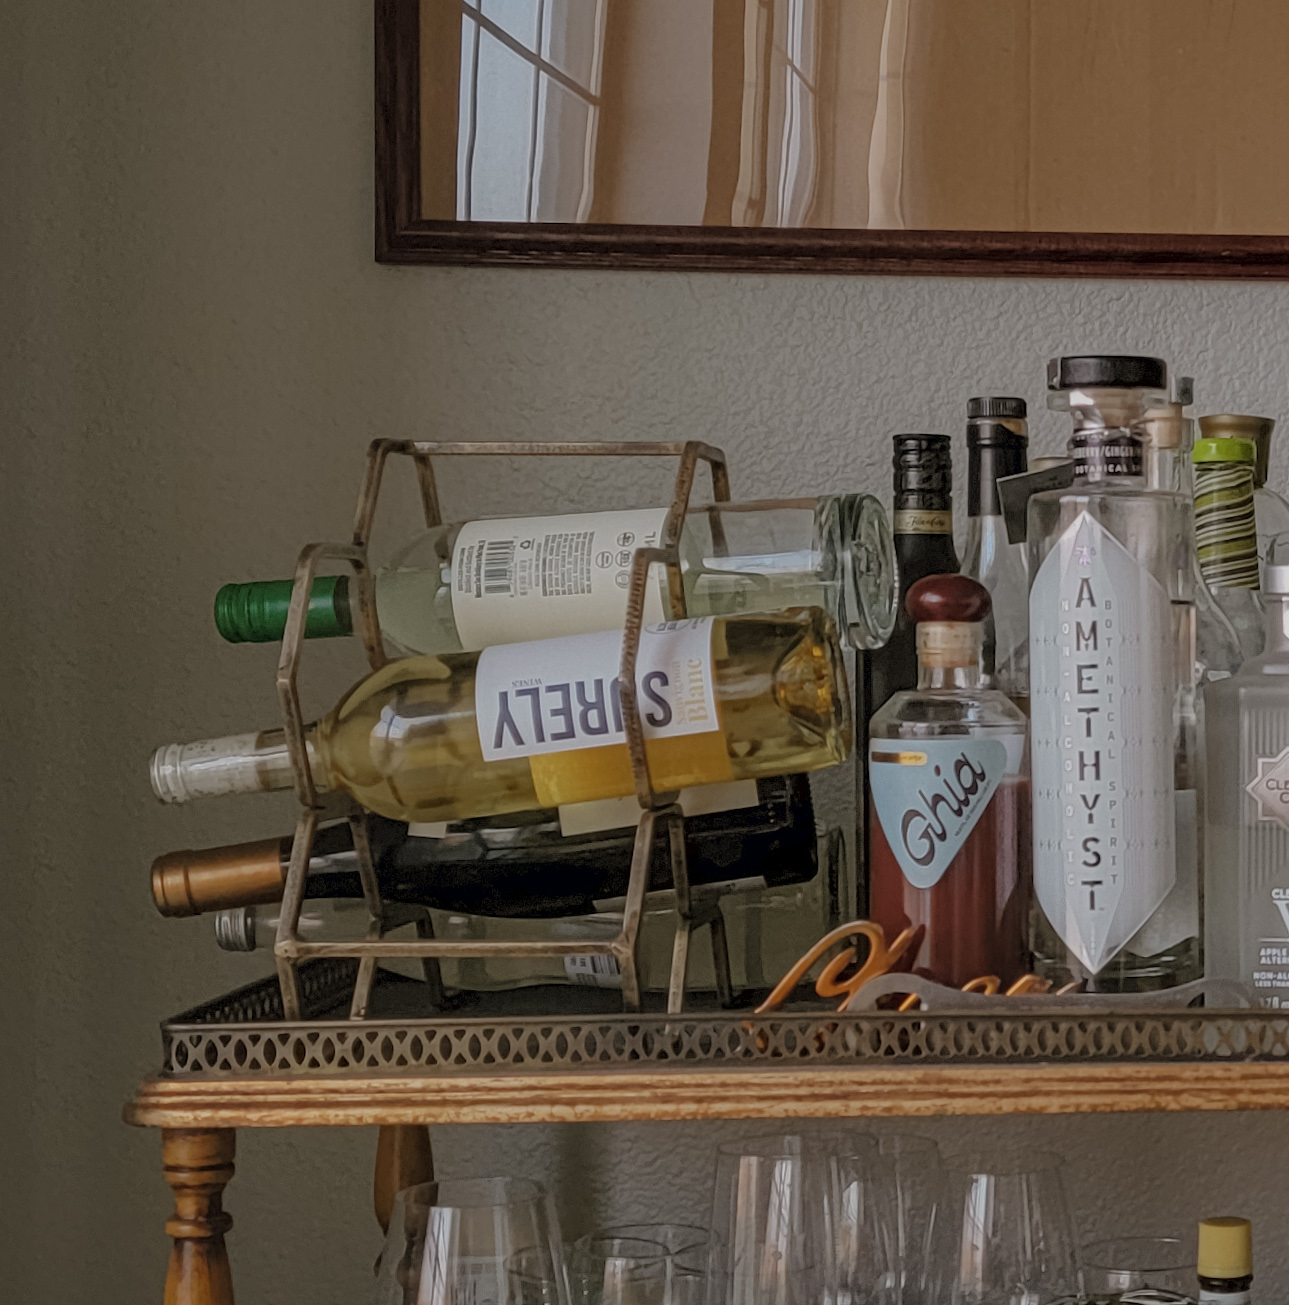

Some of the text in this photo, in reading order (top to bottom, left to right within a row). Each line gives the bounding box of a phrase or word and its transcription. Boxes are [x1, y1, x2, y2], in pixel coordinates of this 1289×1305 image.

[684, 657, 709, 724] Blanc
[1061, 599, 1075, 886] NON-ALCOHOLIC
[1075, 576, 1103, 911] AMETHYST
[1104, 600, 1119, 885] BOTANICAL SPIRIT
[901, 751, 986, 867] Ghia
[1260, 948, 1288, 957] APPLE
